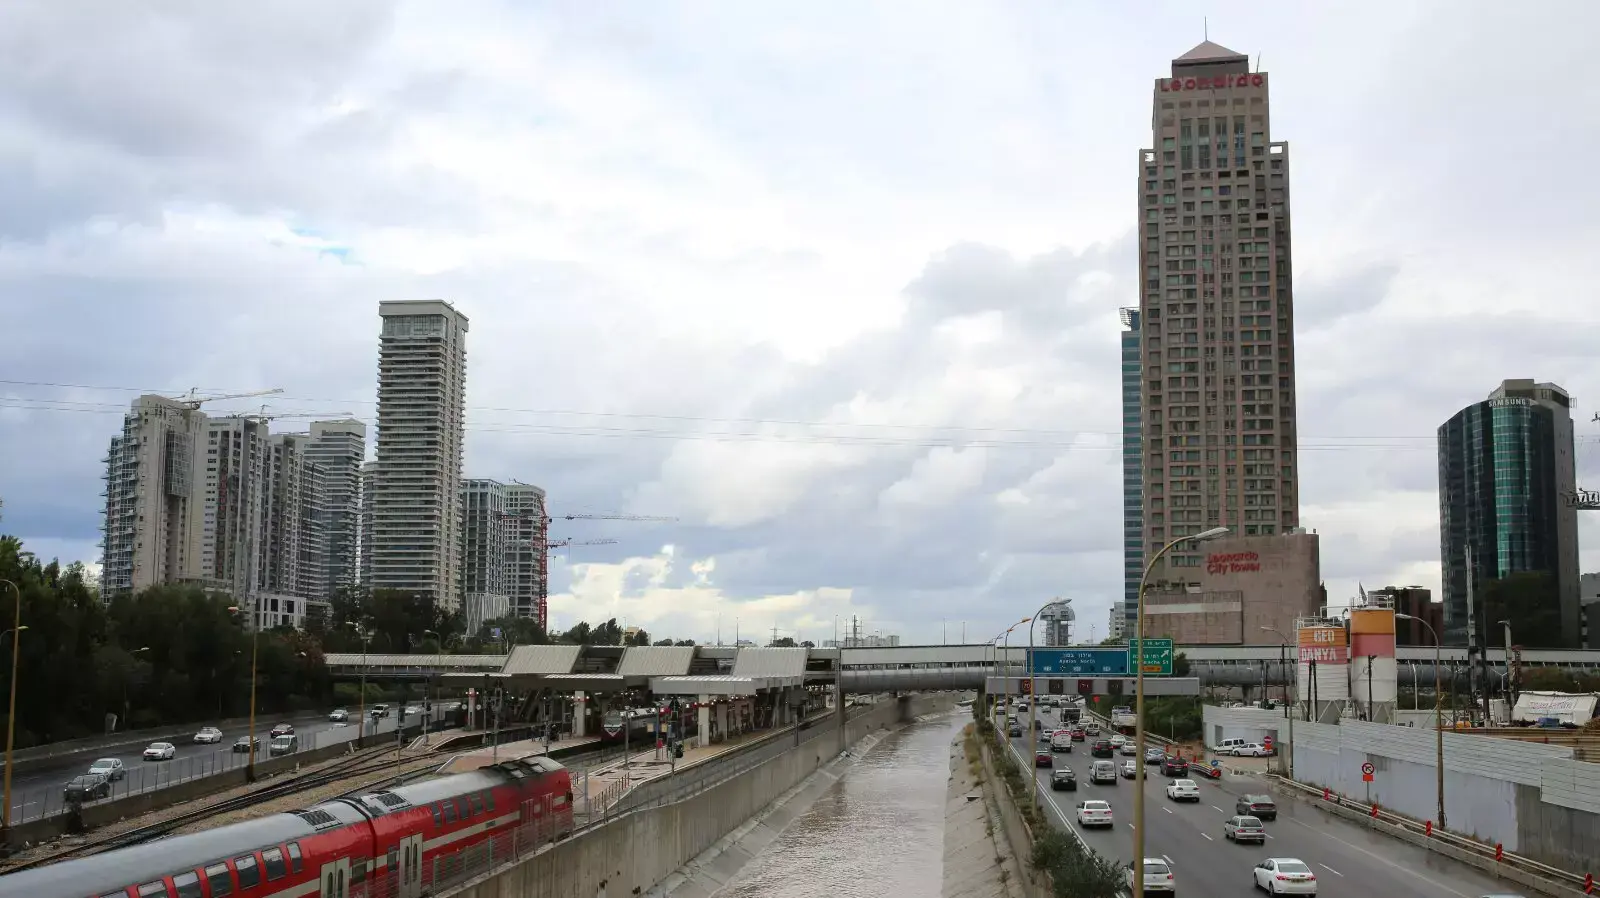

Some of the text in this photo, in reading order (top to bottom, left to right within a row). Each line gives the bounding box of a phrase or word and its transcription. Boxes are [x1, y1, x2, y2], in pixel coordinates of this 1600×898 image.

[1488, 398, 1526, 407] SAMSUNG
[1207, 562, 1260, 576] City Tower
[1313, 630, 1335, 642] GEO
[1301, 648, 1337, 661] DANYA
